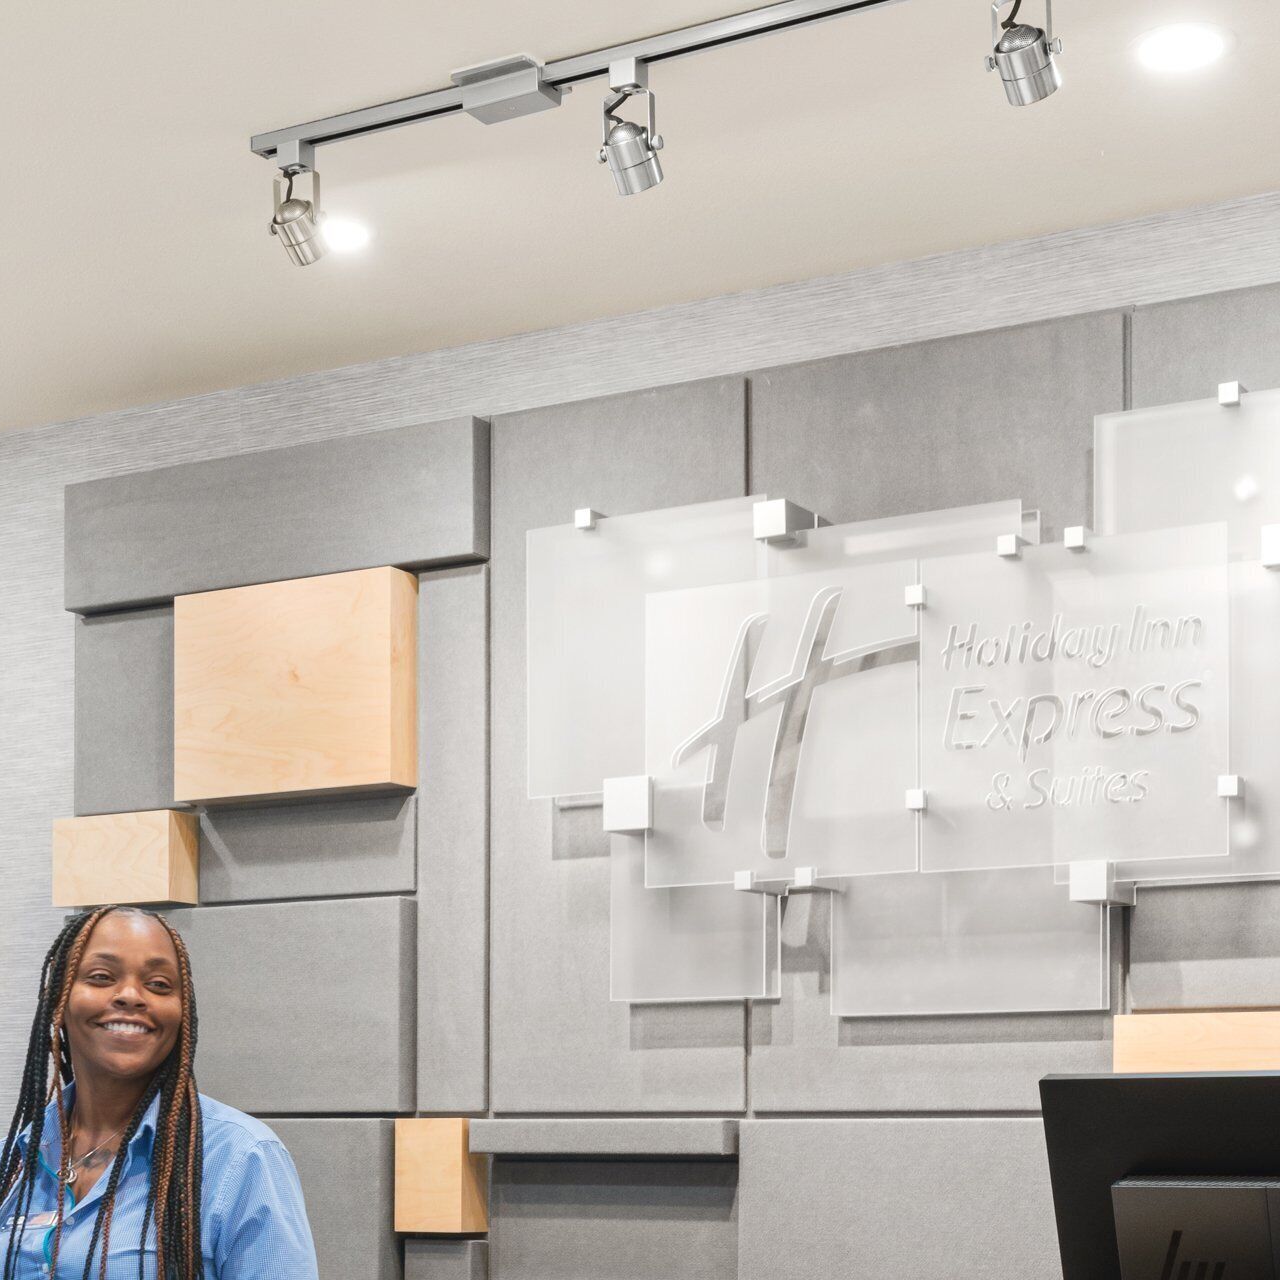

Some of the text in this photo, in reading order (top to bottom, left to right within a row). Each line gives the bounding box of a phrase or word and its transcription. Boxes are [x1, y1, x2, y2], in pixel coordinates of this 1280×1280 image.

[941, 605, 1202, 671] Holiday Inn
[943, 679, 1202, 763] Express
[986, 765, 1149, 810] & Suites
